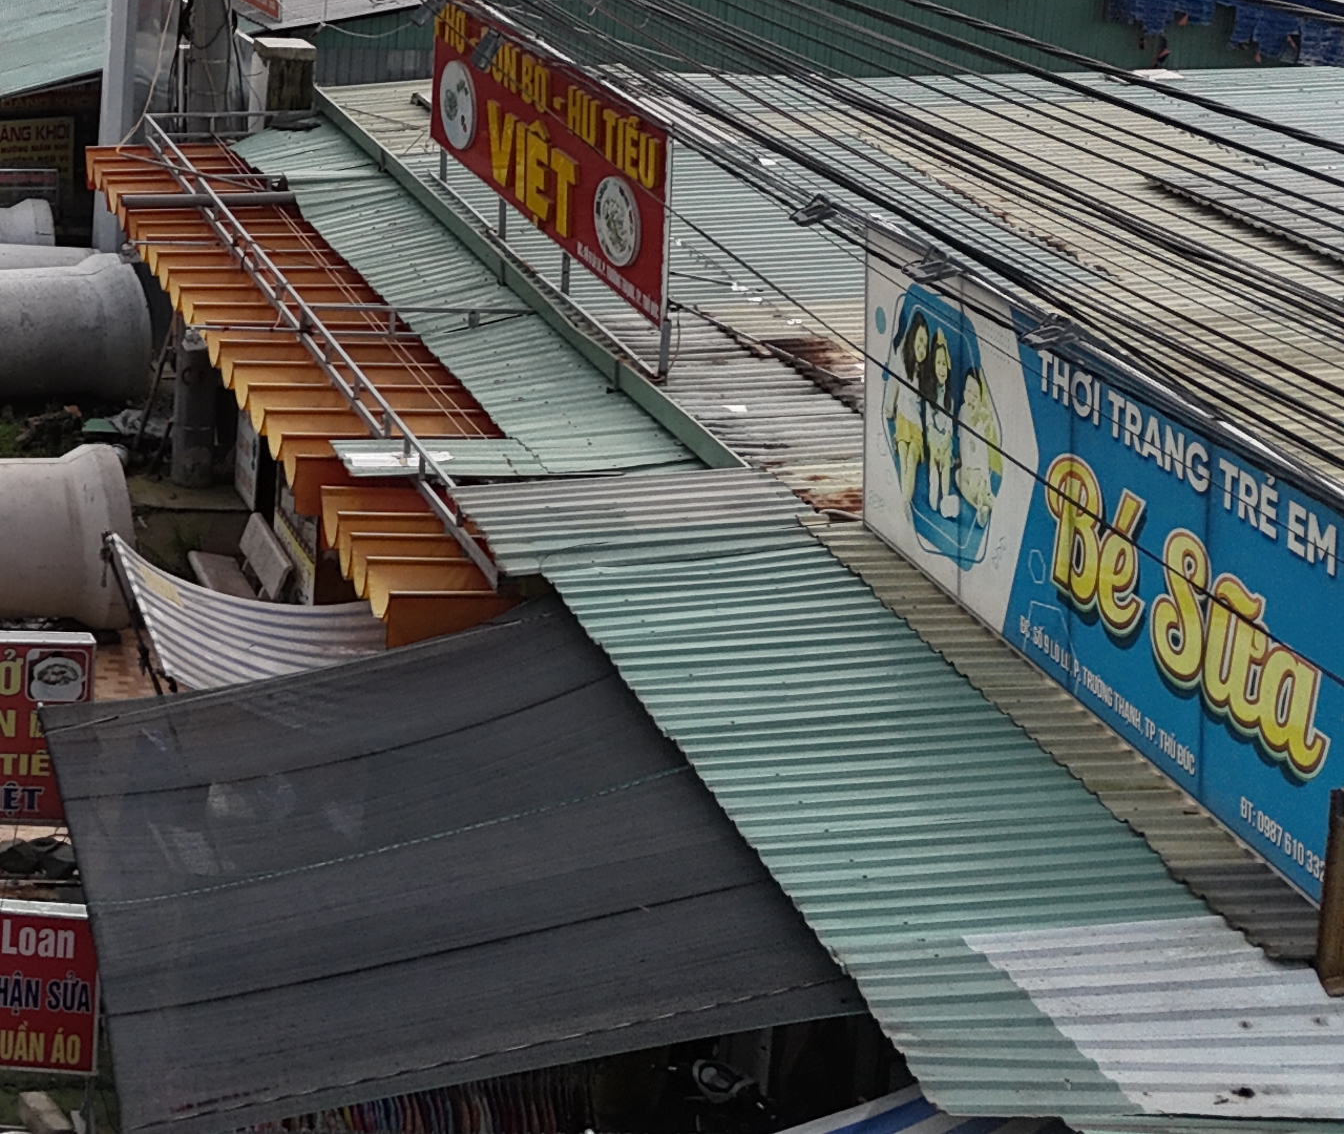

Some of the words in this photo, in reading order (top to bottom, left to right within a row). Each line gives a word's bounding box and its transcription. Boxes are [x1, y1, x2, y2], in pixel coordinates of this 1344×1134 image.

[487, 99, 579, 239] VIỆT
[1107, 392, 1212, 494] TRANG
[1218, 456, 1280, 541] TRẺ
[1287, 505, 1338, 577] EM
[1044, 453, 1146, 638] Bé
[1150, 528, 1332, 783] Sữa
[1257, 810, 1283, 847] 0987
[1284, 831, 1305, 866] 610
[1, 919, 76, 959] Loan
[46, 971, 92, 1015] SỬA
[50, 1027, 81, 1066] ÁO
